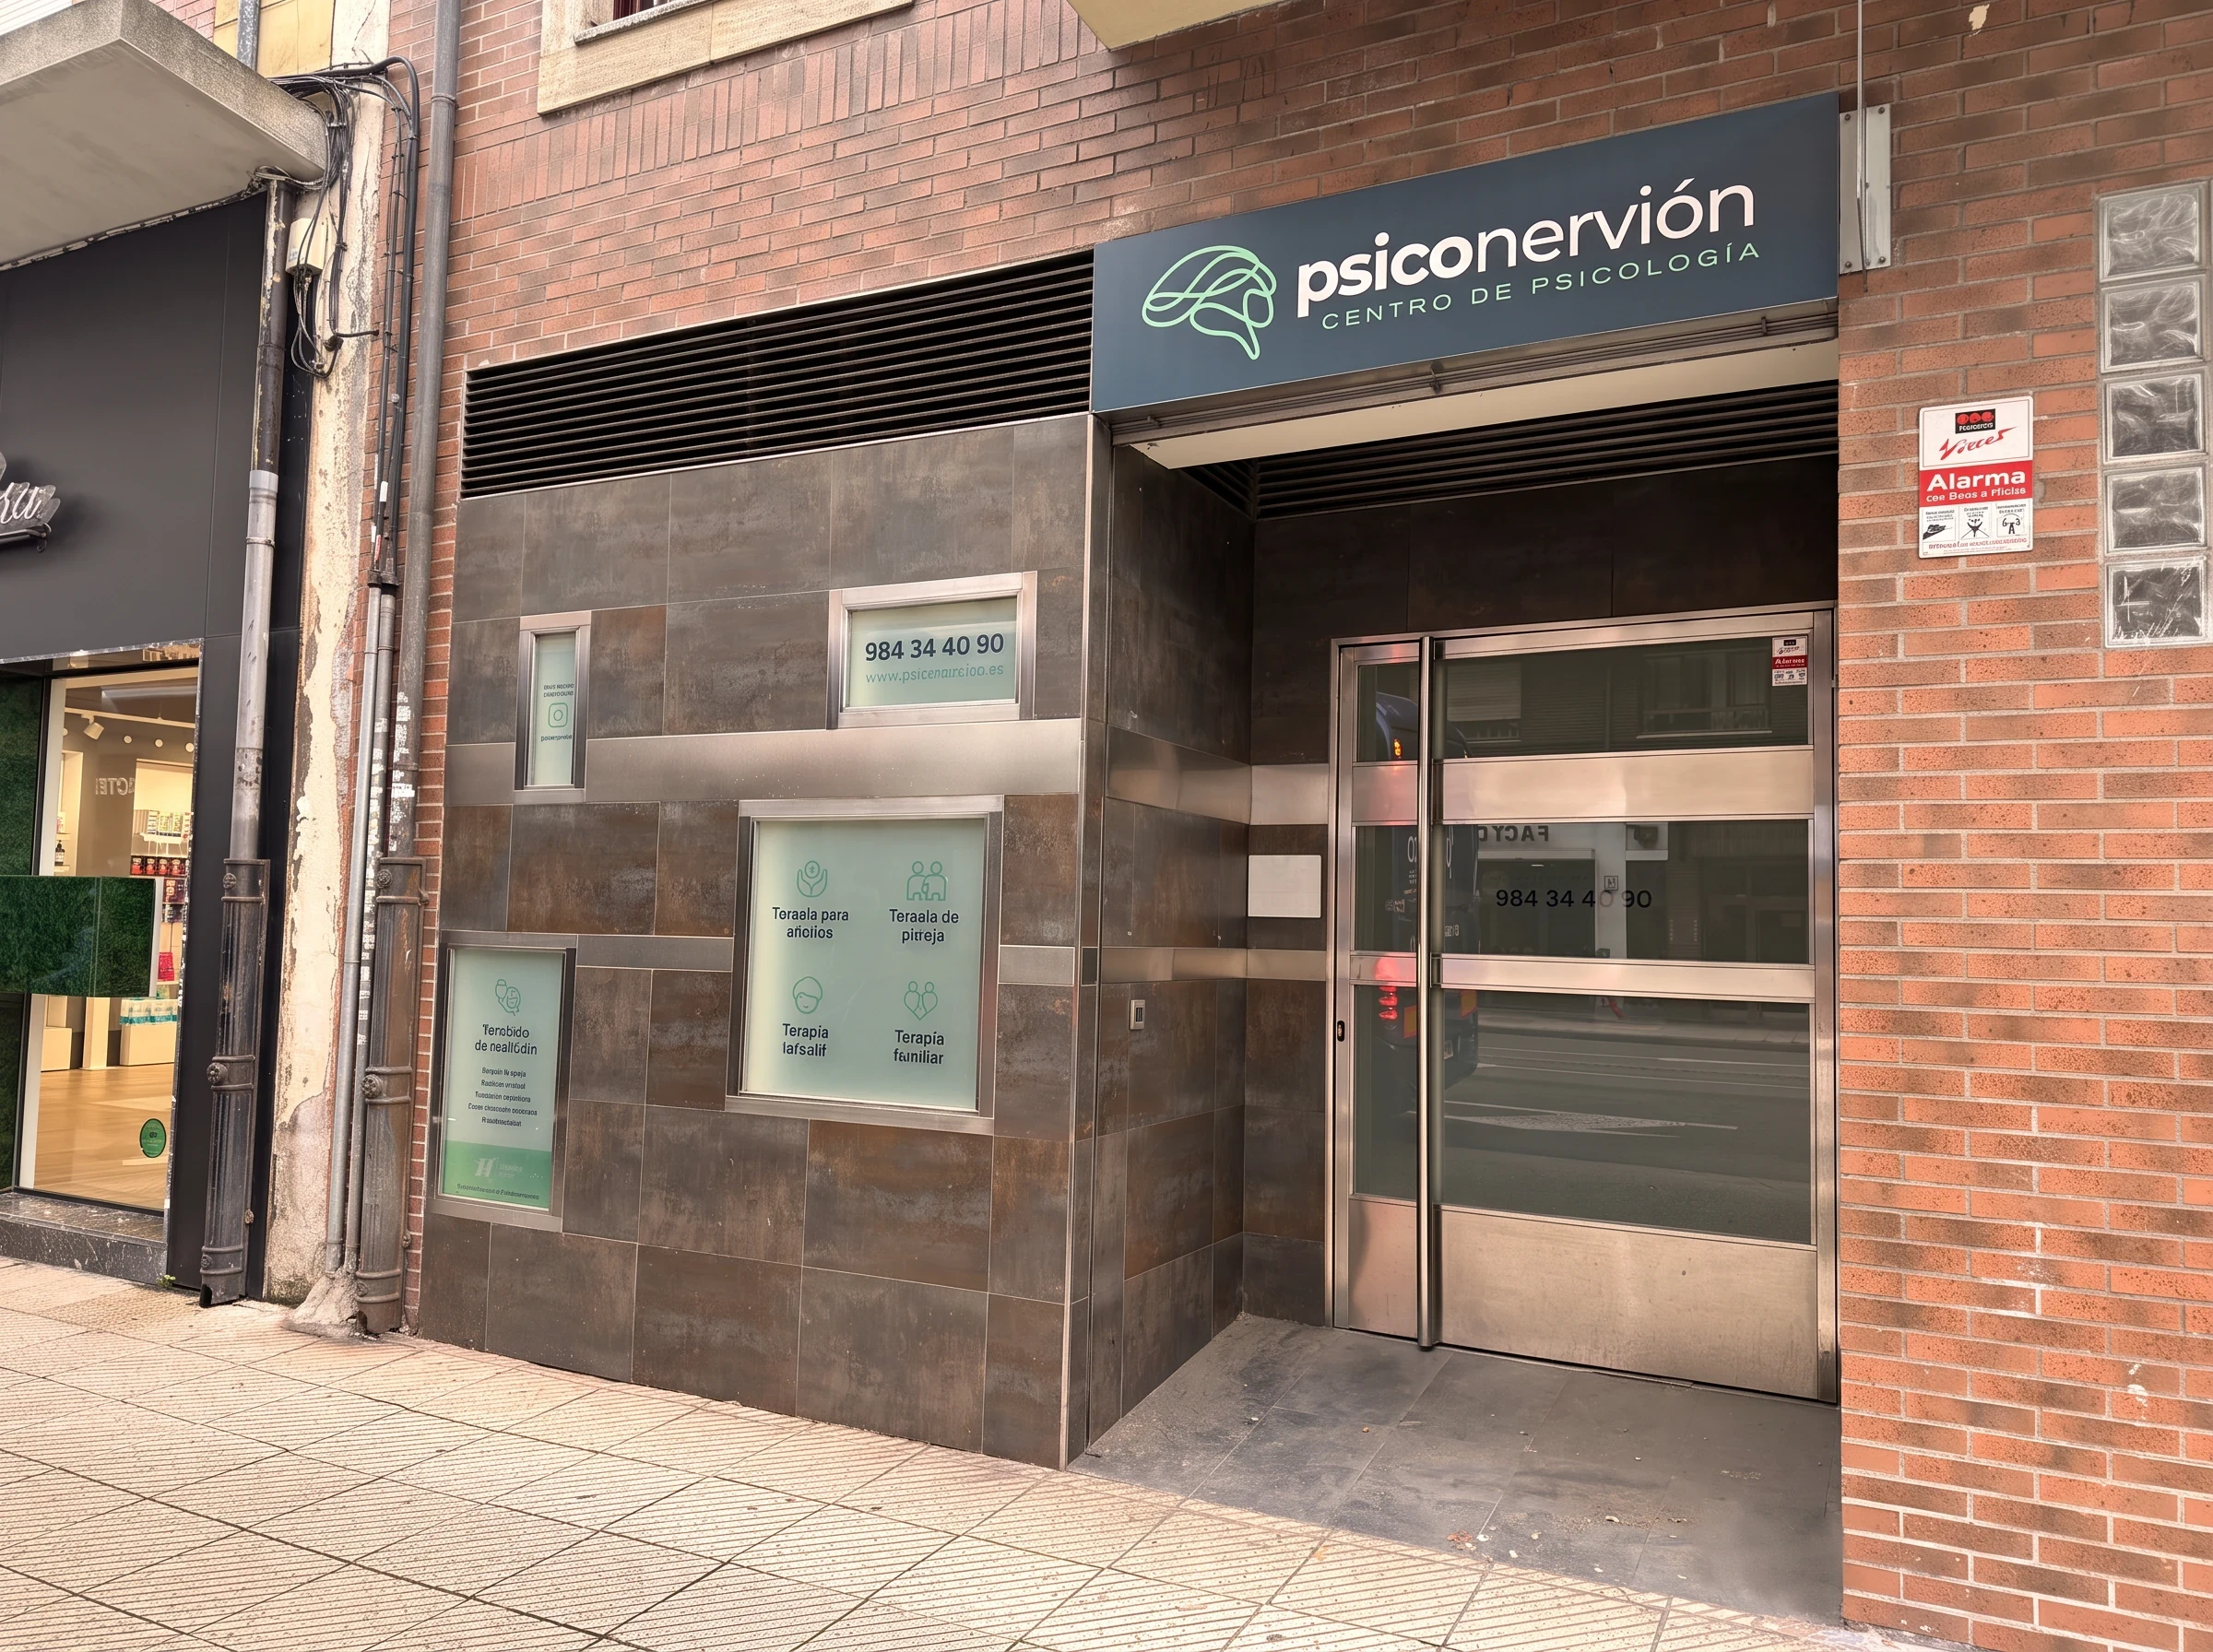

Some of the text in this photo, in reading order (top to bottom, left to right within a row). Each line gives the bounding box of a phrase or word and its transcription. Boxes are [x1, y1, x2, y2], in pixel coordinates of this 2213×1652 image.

[1296, 178, 1756, 318] psiconervión
[1321, 242, 1760, 330] CENTRO DE PSICOLOGÍA
[1926, 470, 2026, 492] Alarma
[865, 632, 1004, 662] 984 34 40 90
[1496, 890, 1652, 909] 984 34 40 90
[821, 910, 849, 925] para
[941, 909, 960, 925] de
[474, 1039, 488, 1052] de
